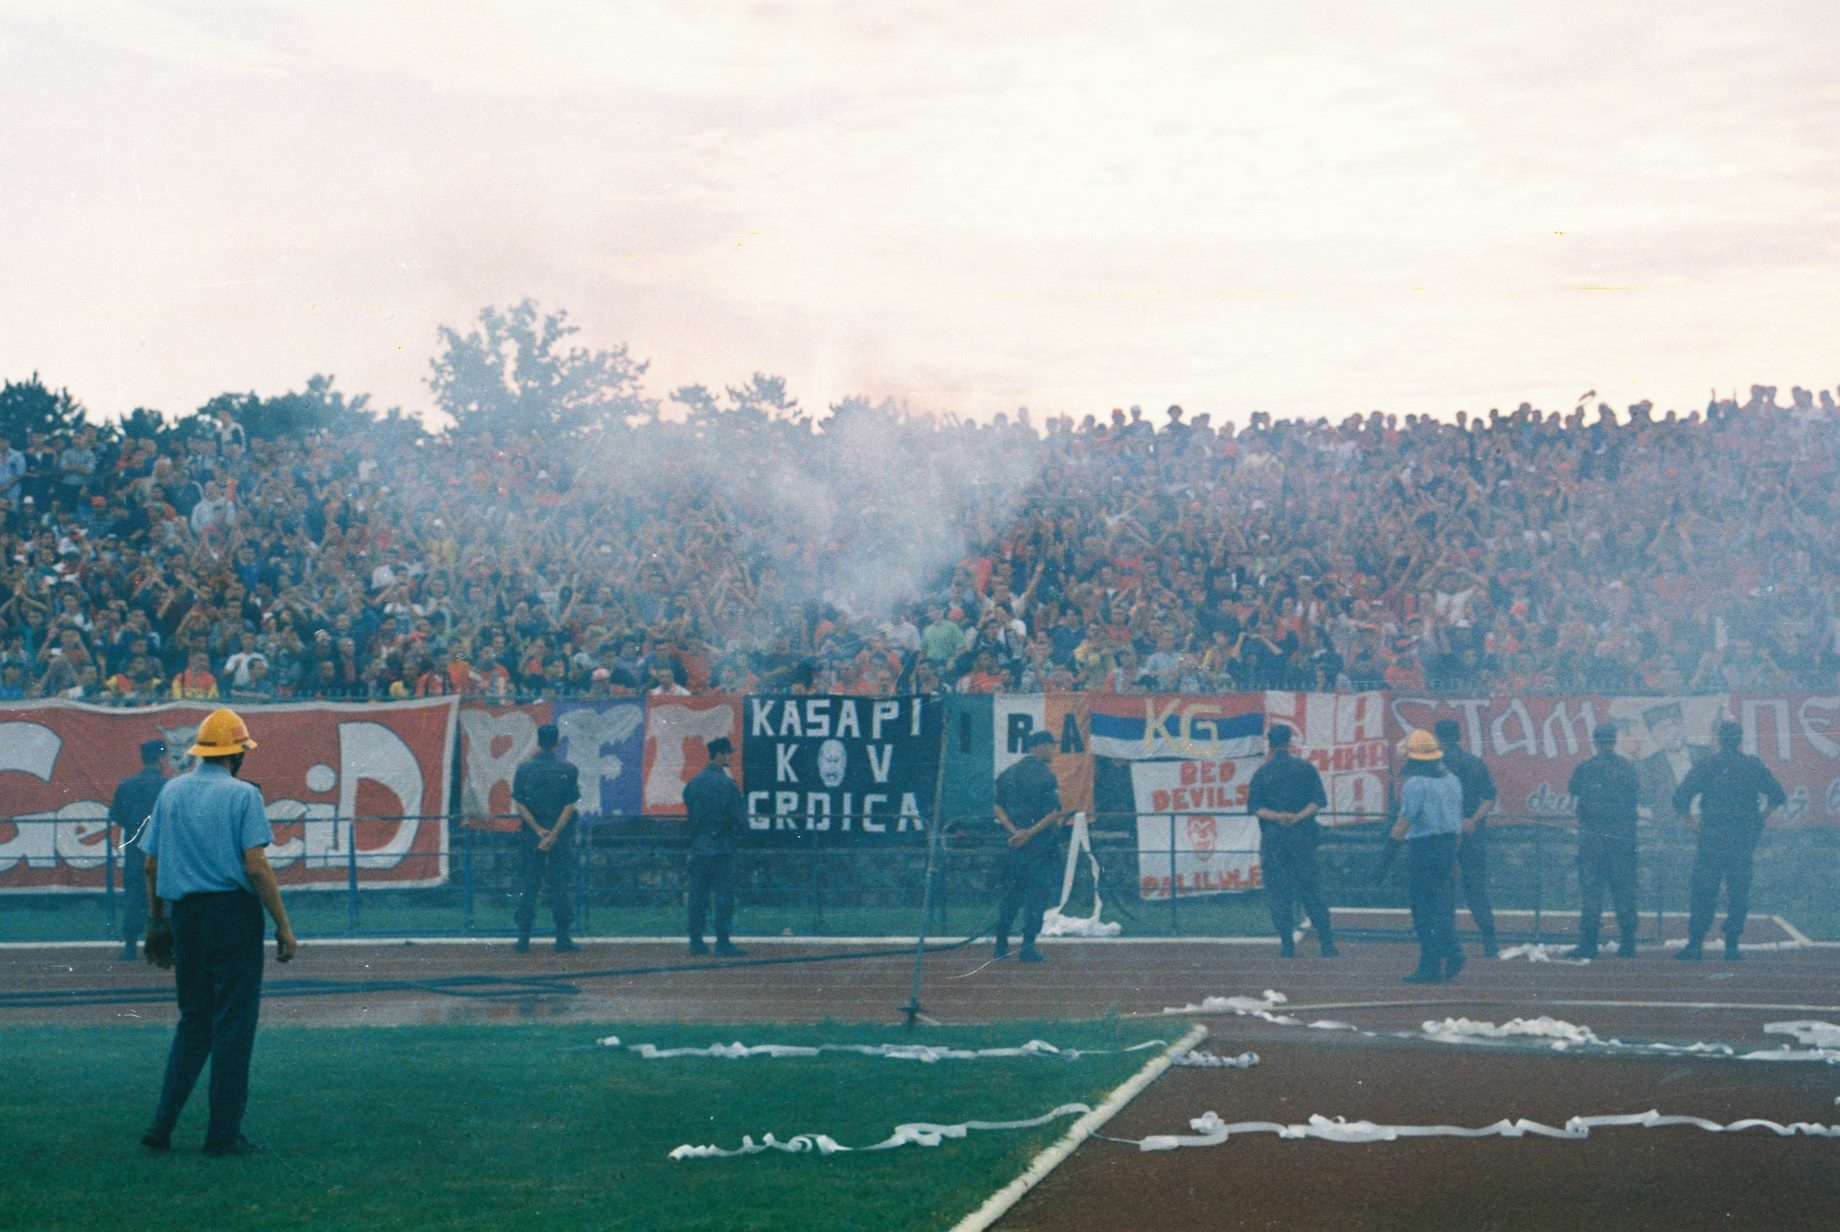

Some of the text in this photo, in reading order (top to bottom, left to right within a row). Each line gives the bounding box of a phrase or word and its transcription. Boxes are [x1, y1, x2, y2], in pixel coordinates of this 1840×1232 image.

[751, 698, 922, 738] KASAPI
[960, 712, 1085, 755] IRA
[1143, 698, 1222, 755] KG
[1180, 760, 1236, 785] RED
[1151, 783, 1249, 812] DEVILS
